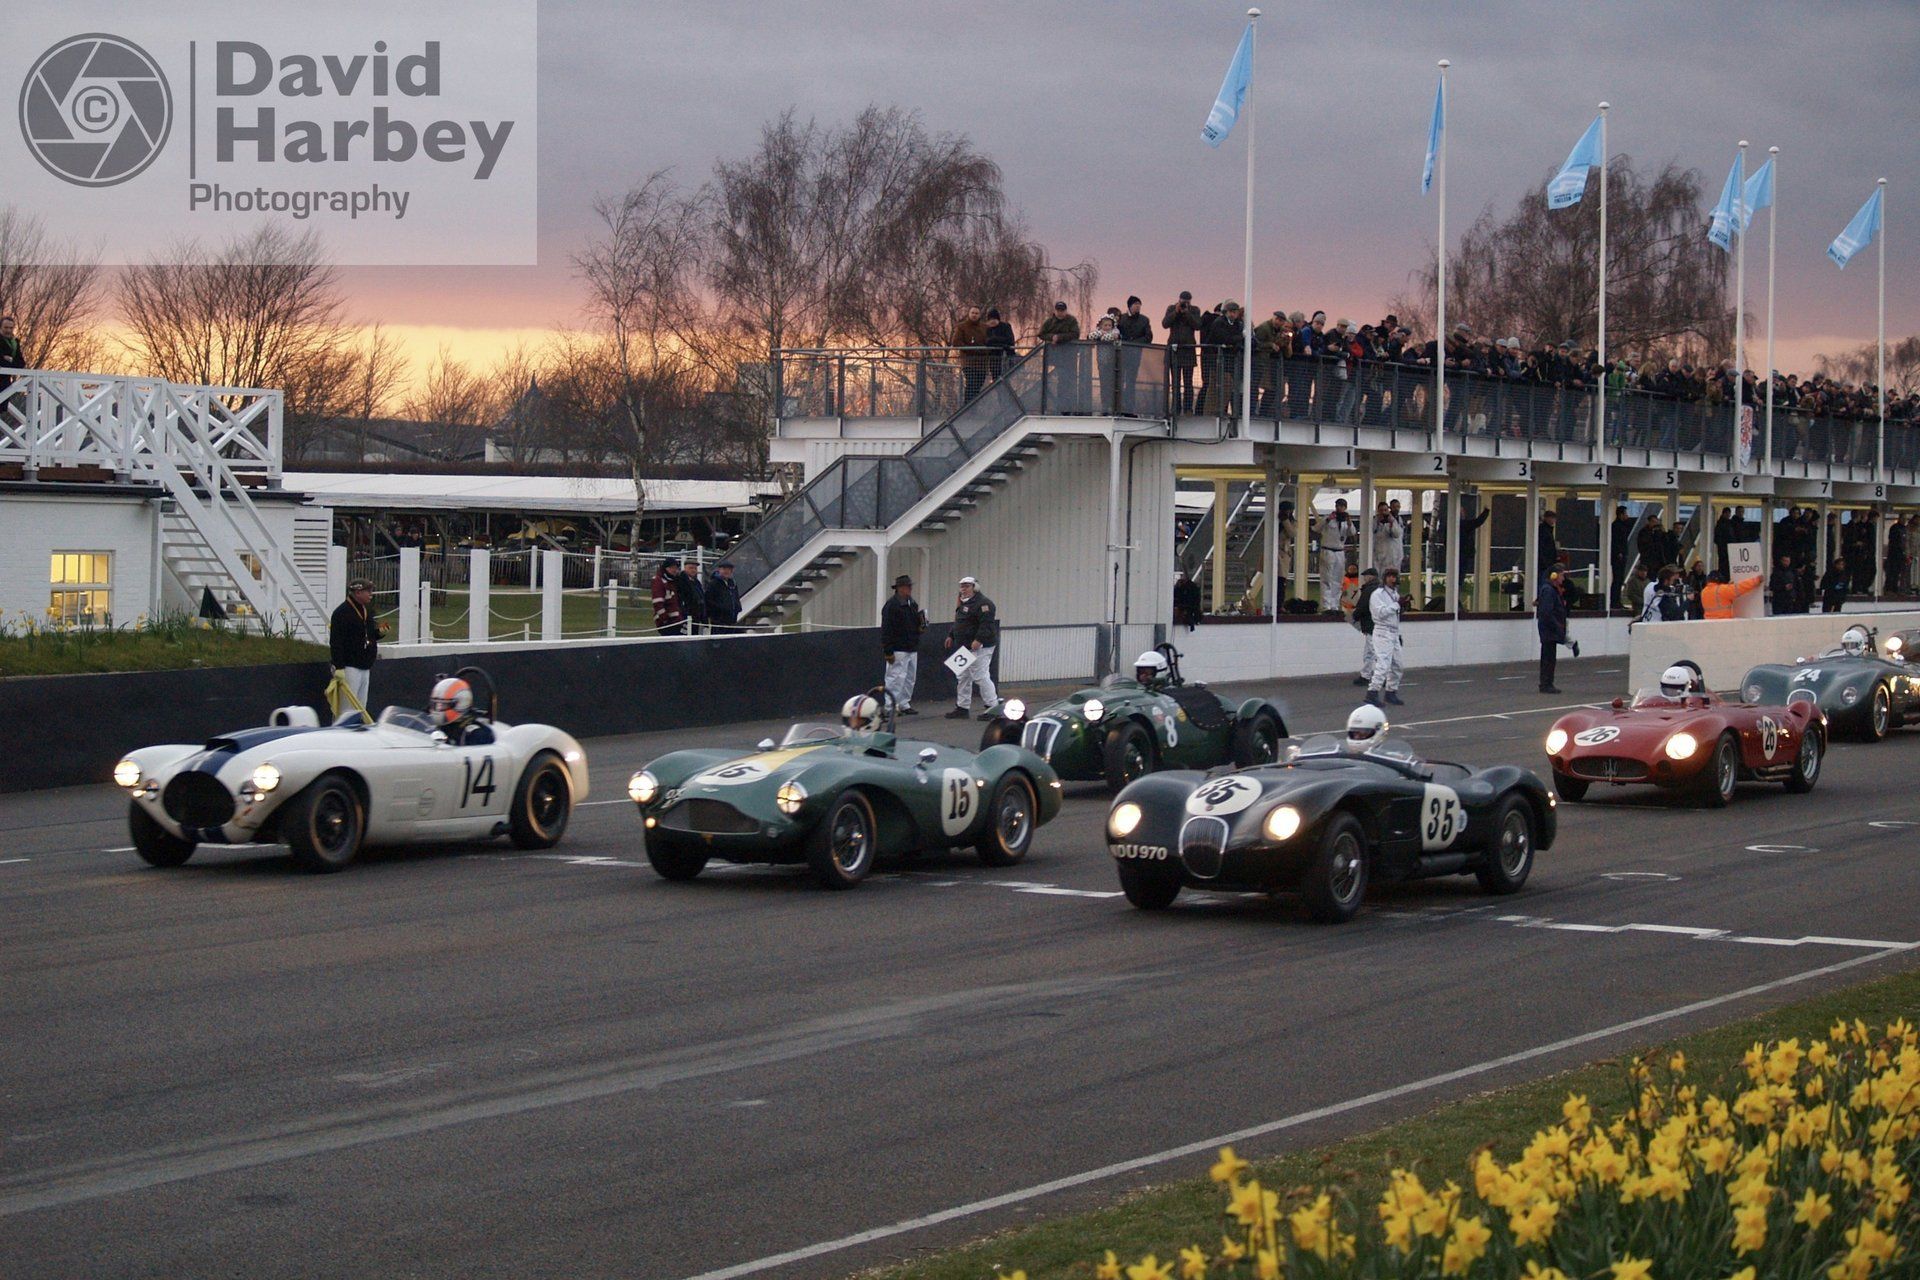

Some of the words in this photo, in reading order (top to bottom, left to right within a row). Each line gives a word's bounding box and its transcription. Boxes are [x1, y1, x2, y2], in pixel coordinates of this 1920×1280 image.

[1347, 450, 1352, 465] 1
[1433, 456, 1443, 471] 2
[1518, 462, 1527, 476] 3
[1594, 467, 1603, 480] 4
[1666, 472, 1674, 484] 5
[1731, 476, 1740, 489] 6
[1821, 482, 1829, 494] 7
[1875, 486, 1883, 498] 8
[1739, 547, 1750, 562] 10
[1732, 565, 1760, 574] SECOND
[1793, 668, 1821, 682] 24
[1165, 715, 1178, 748] 8
[1578, 728, 1617, 743] 26
[707, 762, 761, 779] 15
[460, 755, 496, 808] 14
[949, 778, 970, 819] 15
[1196, 778, 1249, 805] 35
[1427, 797, 1455, 841] 35
